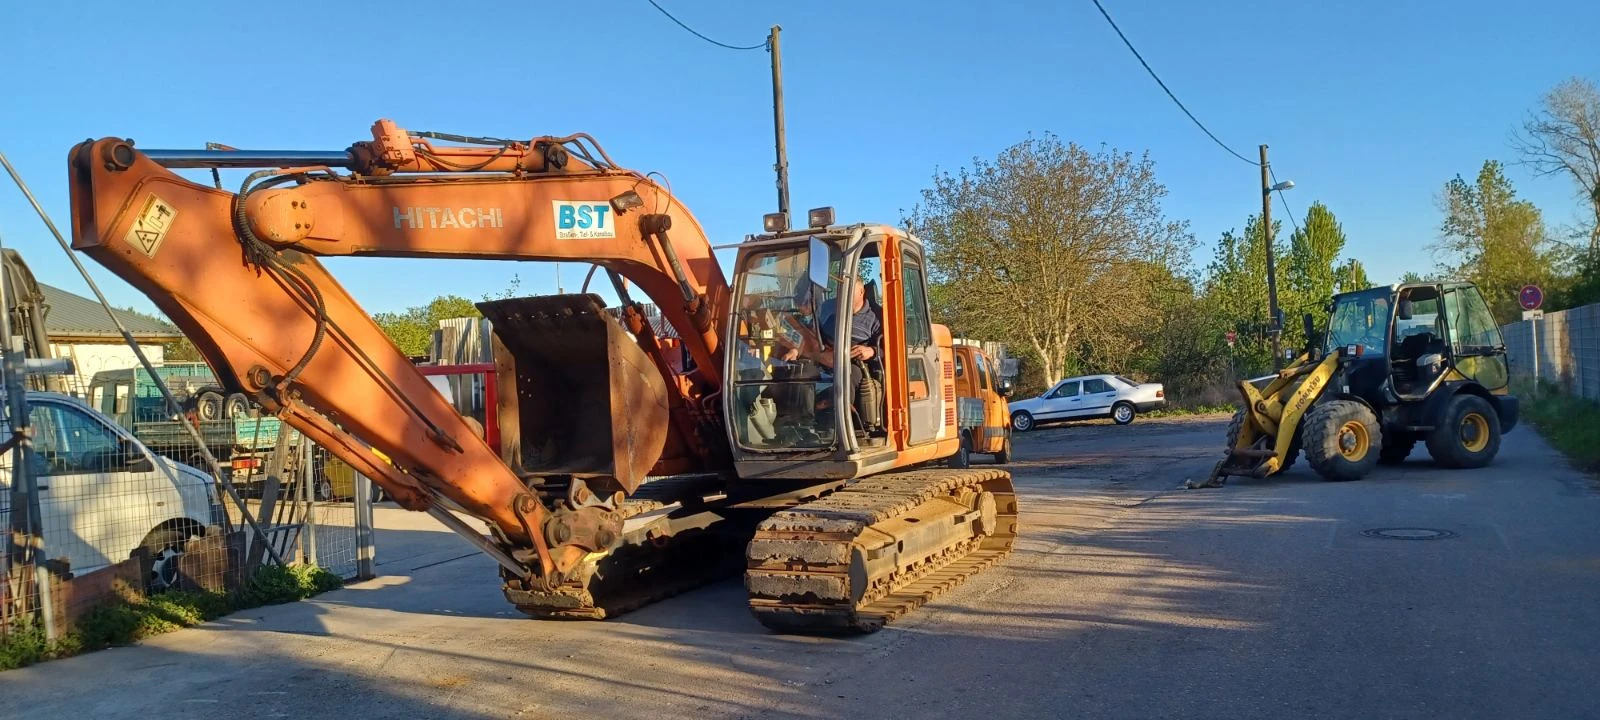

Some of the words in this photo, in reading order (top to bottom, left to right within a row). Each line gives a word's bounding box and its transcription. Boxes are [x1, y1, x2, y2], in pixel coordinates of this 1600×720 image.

[393, 207, 504, 229] HITACHI
[559, 205, 609, 229] BST
[1295, 375, 1321, 410] KOMATSU
